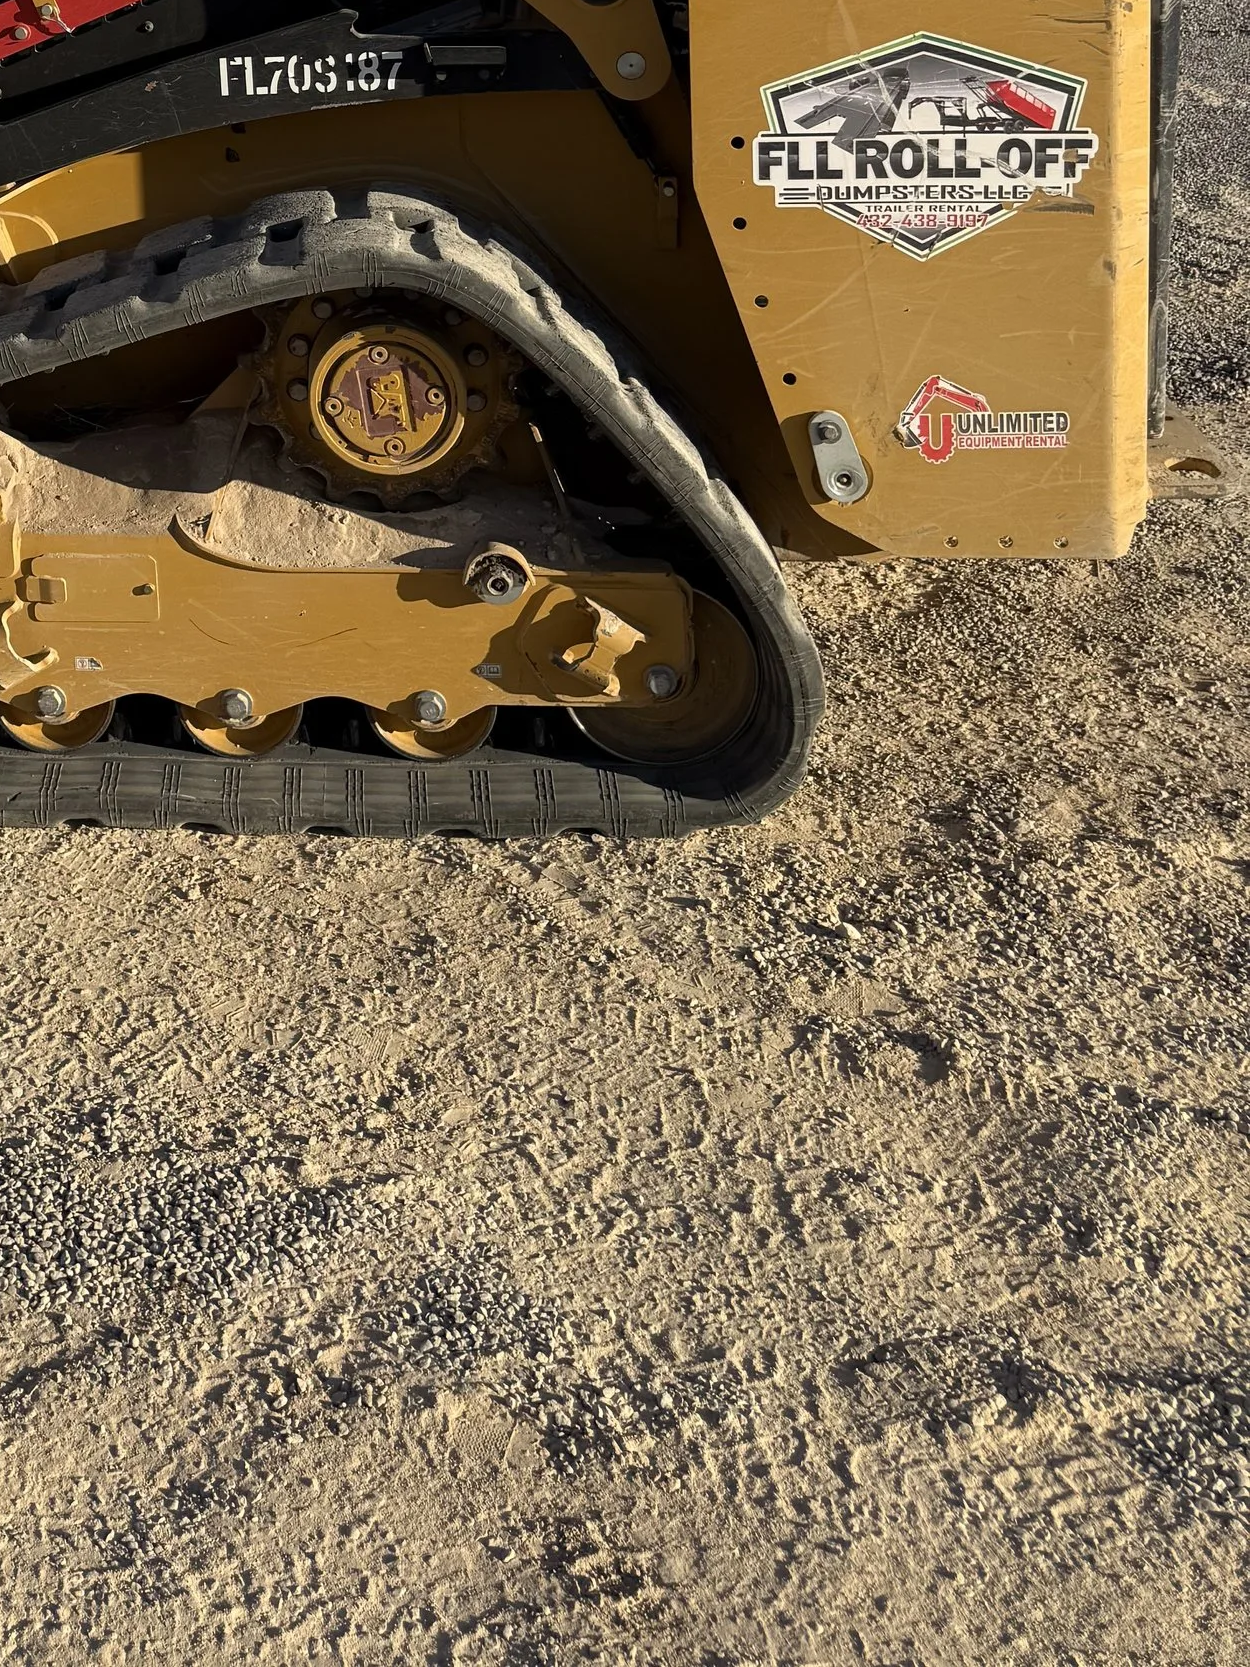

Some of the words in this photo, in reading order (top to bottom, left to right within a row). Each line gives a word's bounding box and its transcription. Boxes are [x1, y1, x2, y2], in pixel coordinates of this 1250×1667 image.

[758, 140, 843, 180] FLL
[818, 184, 982, 200] DUMPSTERS
[983, 184, 1029, 200] LLC
[865, 204, 924, 213] TRAILER
[927, 203, 983, 213] RENTAL
[856, 213, 989, 229] 432-438-9197
[957, 412, 1069, 433] UNLIMITED
[958, 435, 1023, 448] EQUIPMENT
[1025, 435, 1068, 447] RENTAL
